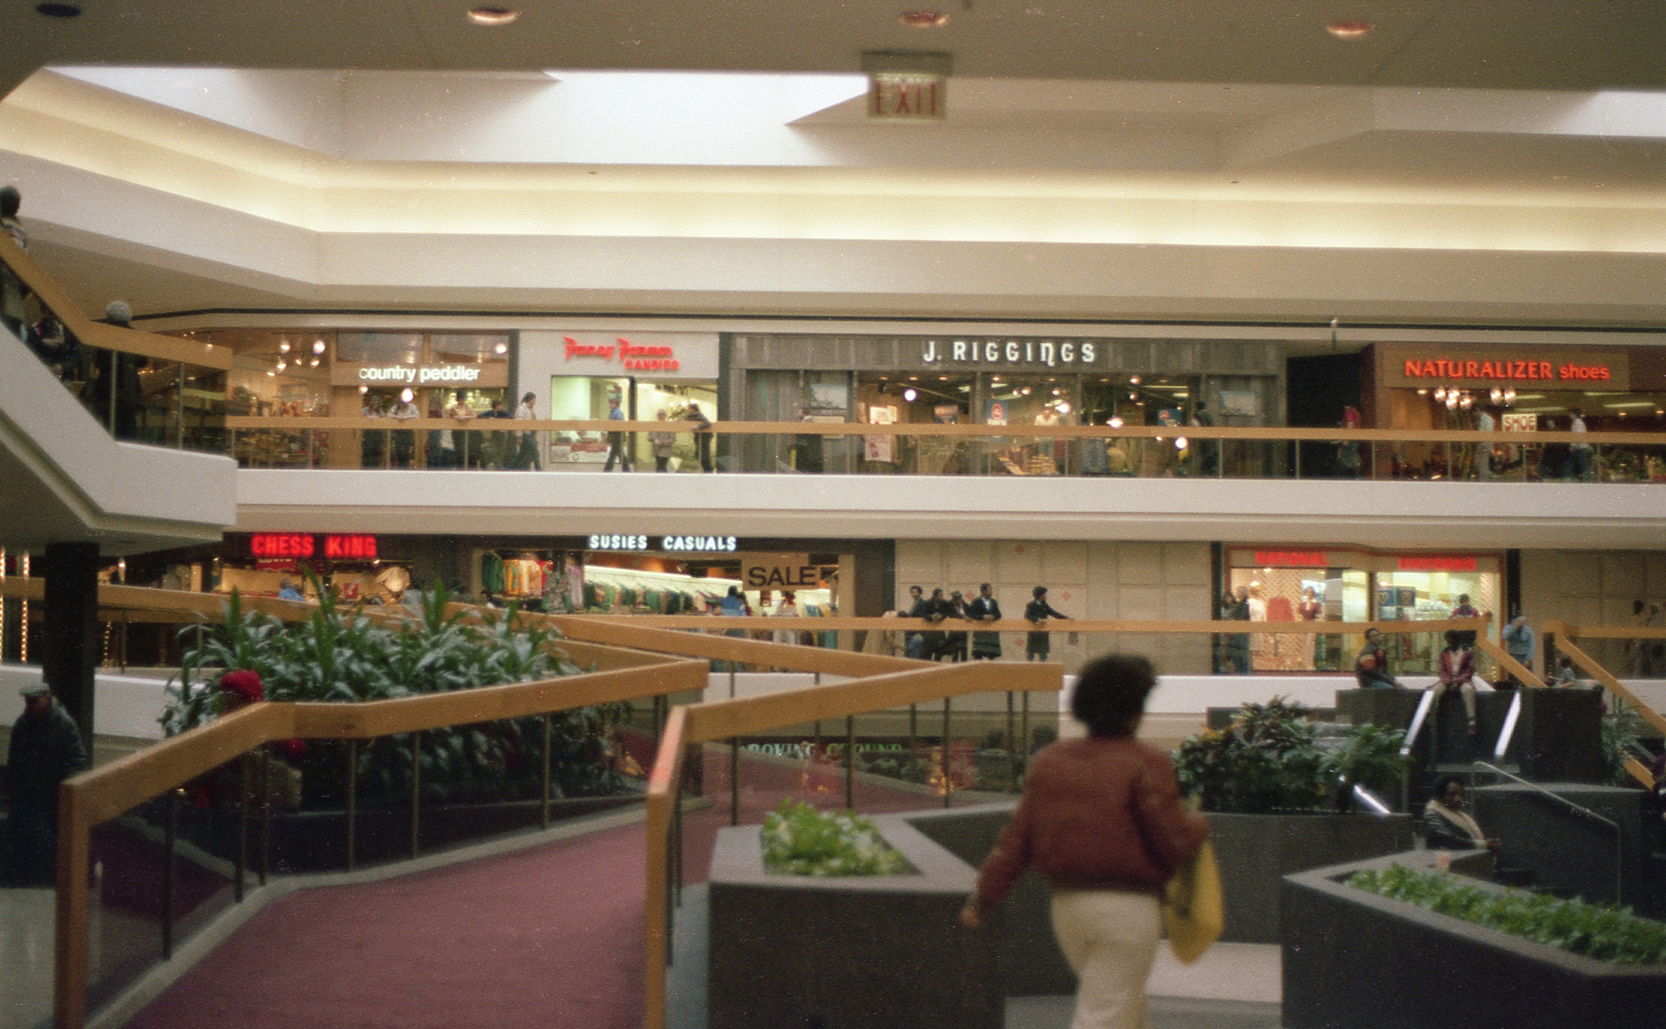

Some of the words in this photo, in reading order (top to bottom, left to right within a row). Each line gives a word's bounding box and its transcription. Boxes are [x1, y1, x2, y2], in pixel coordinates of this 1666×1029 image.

[875, 82, 938, 116] EXIT
[923, 341, 942, 362] J.
[953, 341, 1095, 366] RIGGINGS
[359, 365, 416, 383] country
[420, 365, 480, 383] peddler
[624, 359, 680, 370] CANDIES
[1404, 359, 1552, 379] NATURALIZER
[1559, 363, 1610, 380] shoes
[1503, 416, 1536, 431] SHOE
[252, 533, 315, 558] CHESS
[325, 534, 377, 558] KING
[589, 535, 647, 549] SUSIES
[662, 536, 737, 550] CASUALS
[1255, 552, 1328, 566] NATIONAL
[1398, 557, 1477, 571] UNIFORMS
[747, 566, 818, 587] SALE
[739, 743, 816, 758] ROVING
